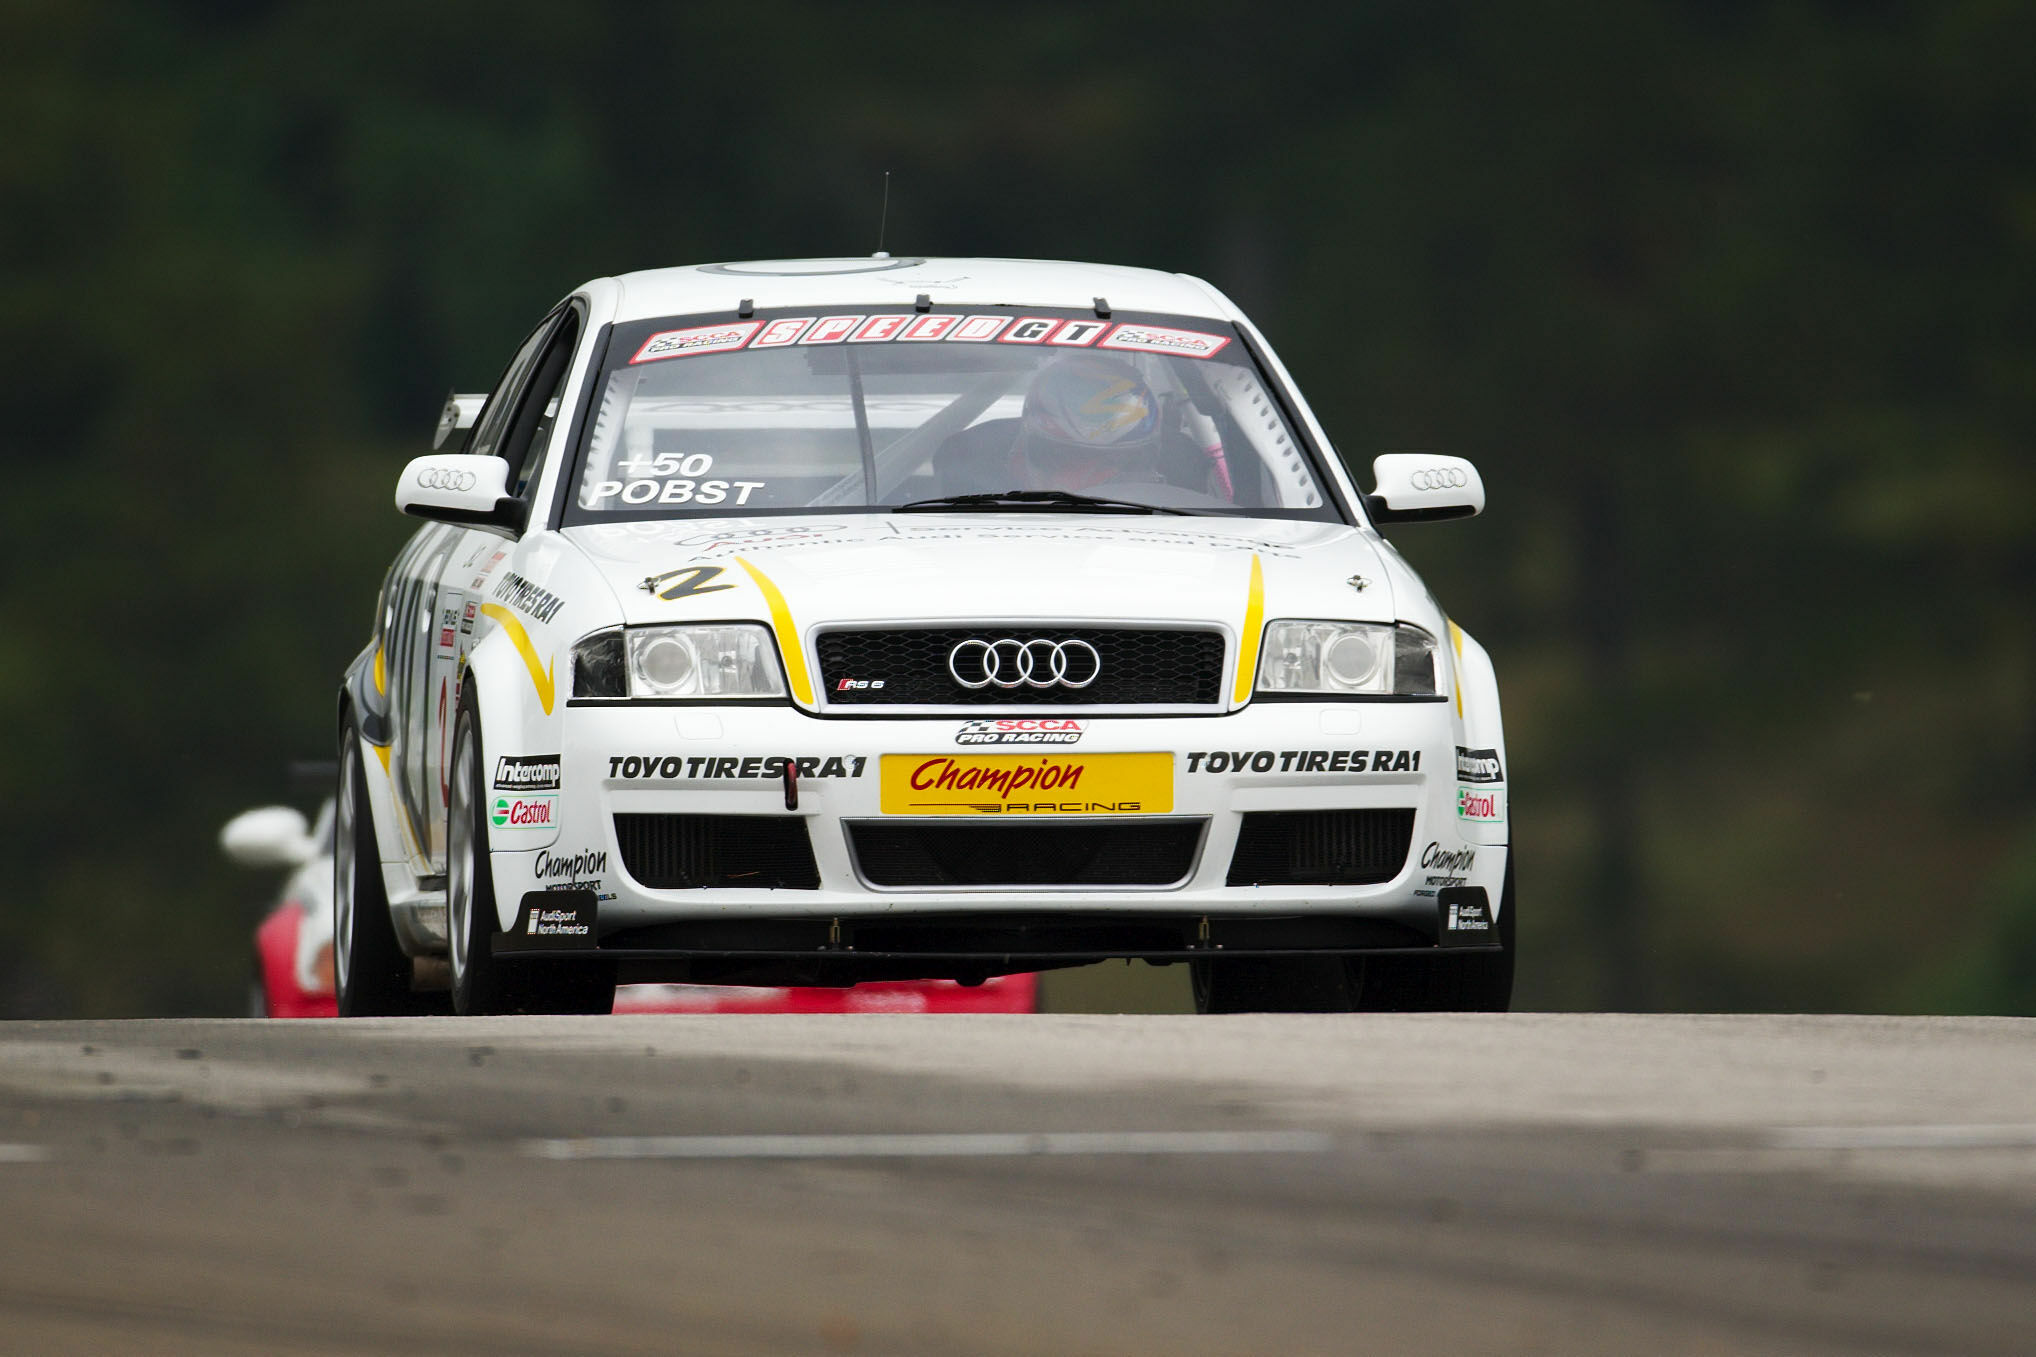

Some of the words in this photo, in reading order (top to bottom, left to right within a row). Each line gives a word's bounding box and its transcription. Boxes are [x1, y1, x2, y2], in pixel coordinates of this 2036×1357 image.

[764, 316, 1004, 343] SPEED
[1013, 320, 1102, 341] GT
[617, 452, 714, 477] +50
[586, 479, 766, 506] POBST
[649, 566, 740, 601] 2
[957, 733, 998, 743] PRO
[1001, 732, 1080, 743] RACING
[995, 720, 1081, 731] SCCA
[496, 758, 560, 787] Intercomp
[609, 756, 682, 778] TOYO
[686, 756, 787, 778] TIRES
[794, 756, 867, 778] RA1
[1187, 750, 1275, 773] TOYO
[1279, 750, 1368, 773] TIRES
[1371, 750, 1421, 772] RA1
[910, 758, 1085, 799] Champion
[510, 800, 551, 824] Castrol
[1007, 802, 1142, 811] RACING
[535, 848, 607, 883] Champion
[1421, 841, 1476, 877] Champion
